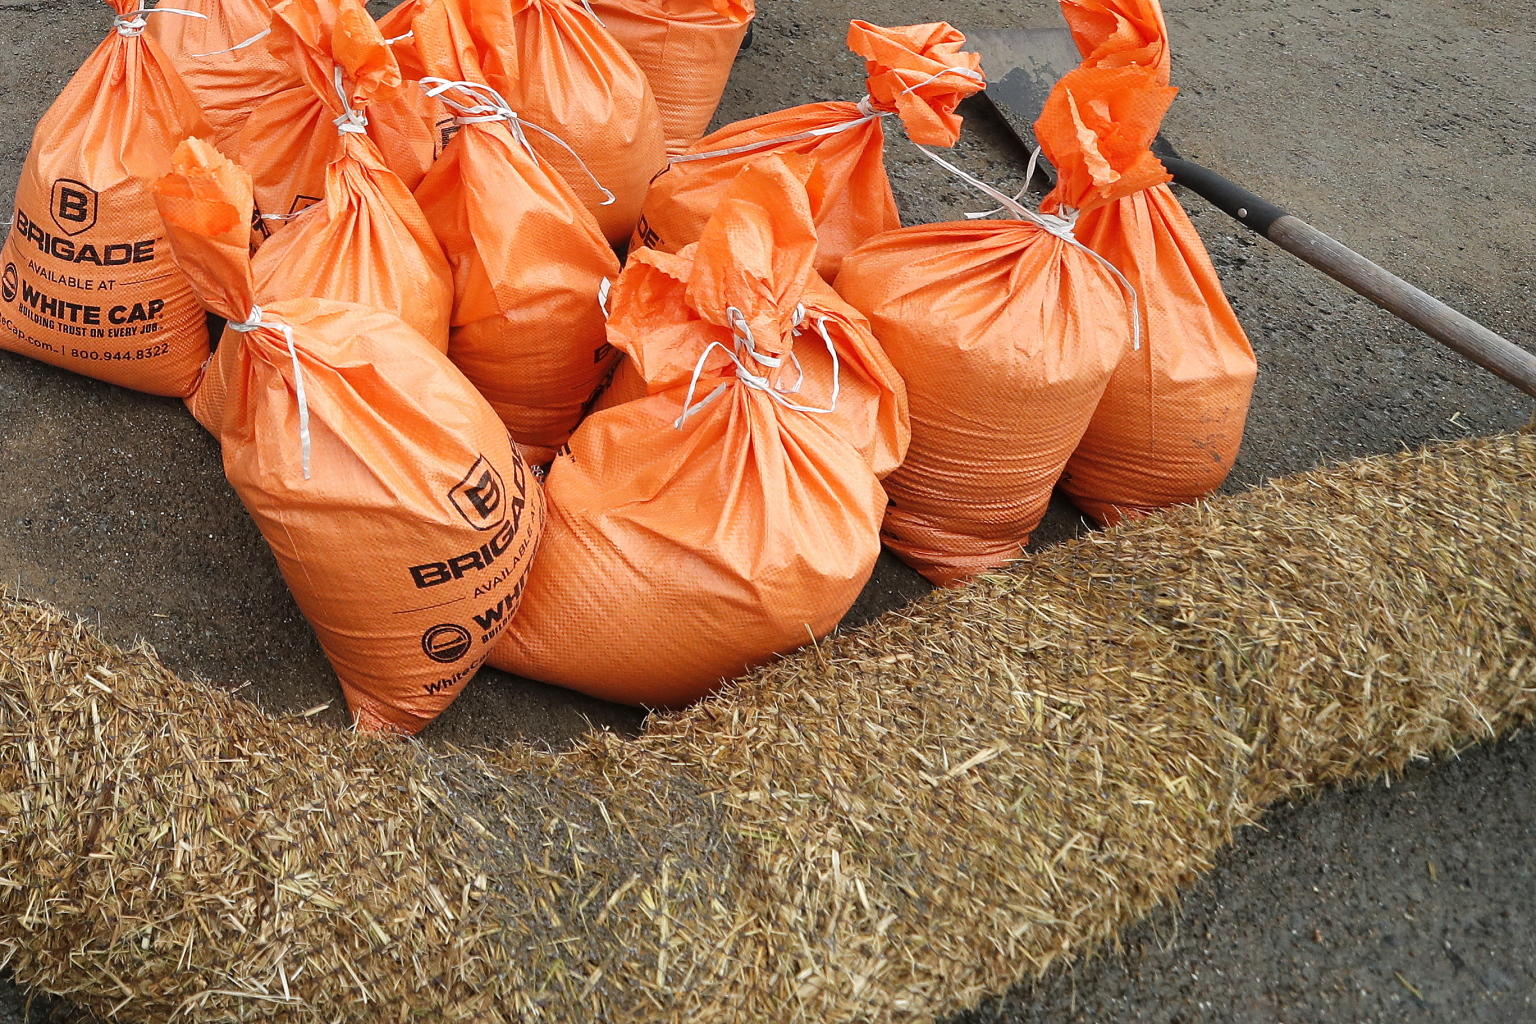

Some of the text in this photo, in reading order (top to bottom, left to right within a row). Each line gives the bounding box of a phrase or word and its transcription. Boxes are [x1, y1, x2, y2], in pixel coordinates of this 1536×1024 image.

[59, 187, 88, 223] B
[16, 208, 156, 267] BRIGADE
[28, 259, 116, 291] AVAILABLE AT
[19, 302, 54, 329] BUILDING
[58, 322, 86, 337] TRUST
[90, 328, 104, 337] ON
[108, 327, 137, 337] EVERY
[22, 279, 101, 325] WHITE
[71, 343, 169, 361] 800.944.8322
[464, 469, 500, 520] B
